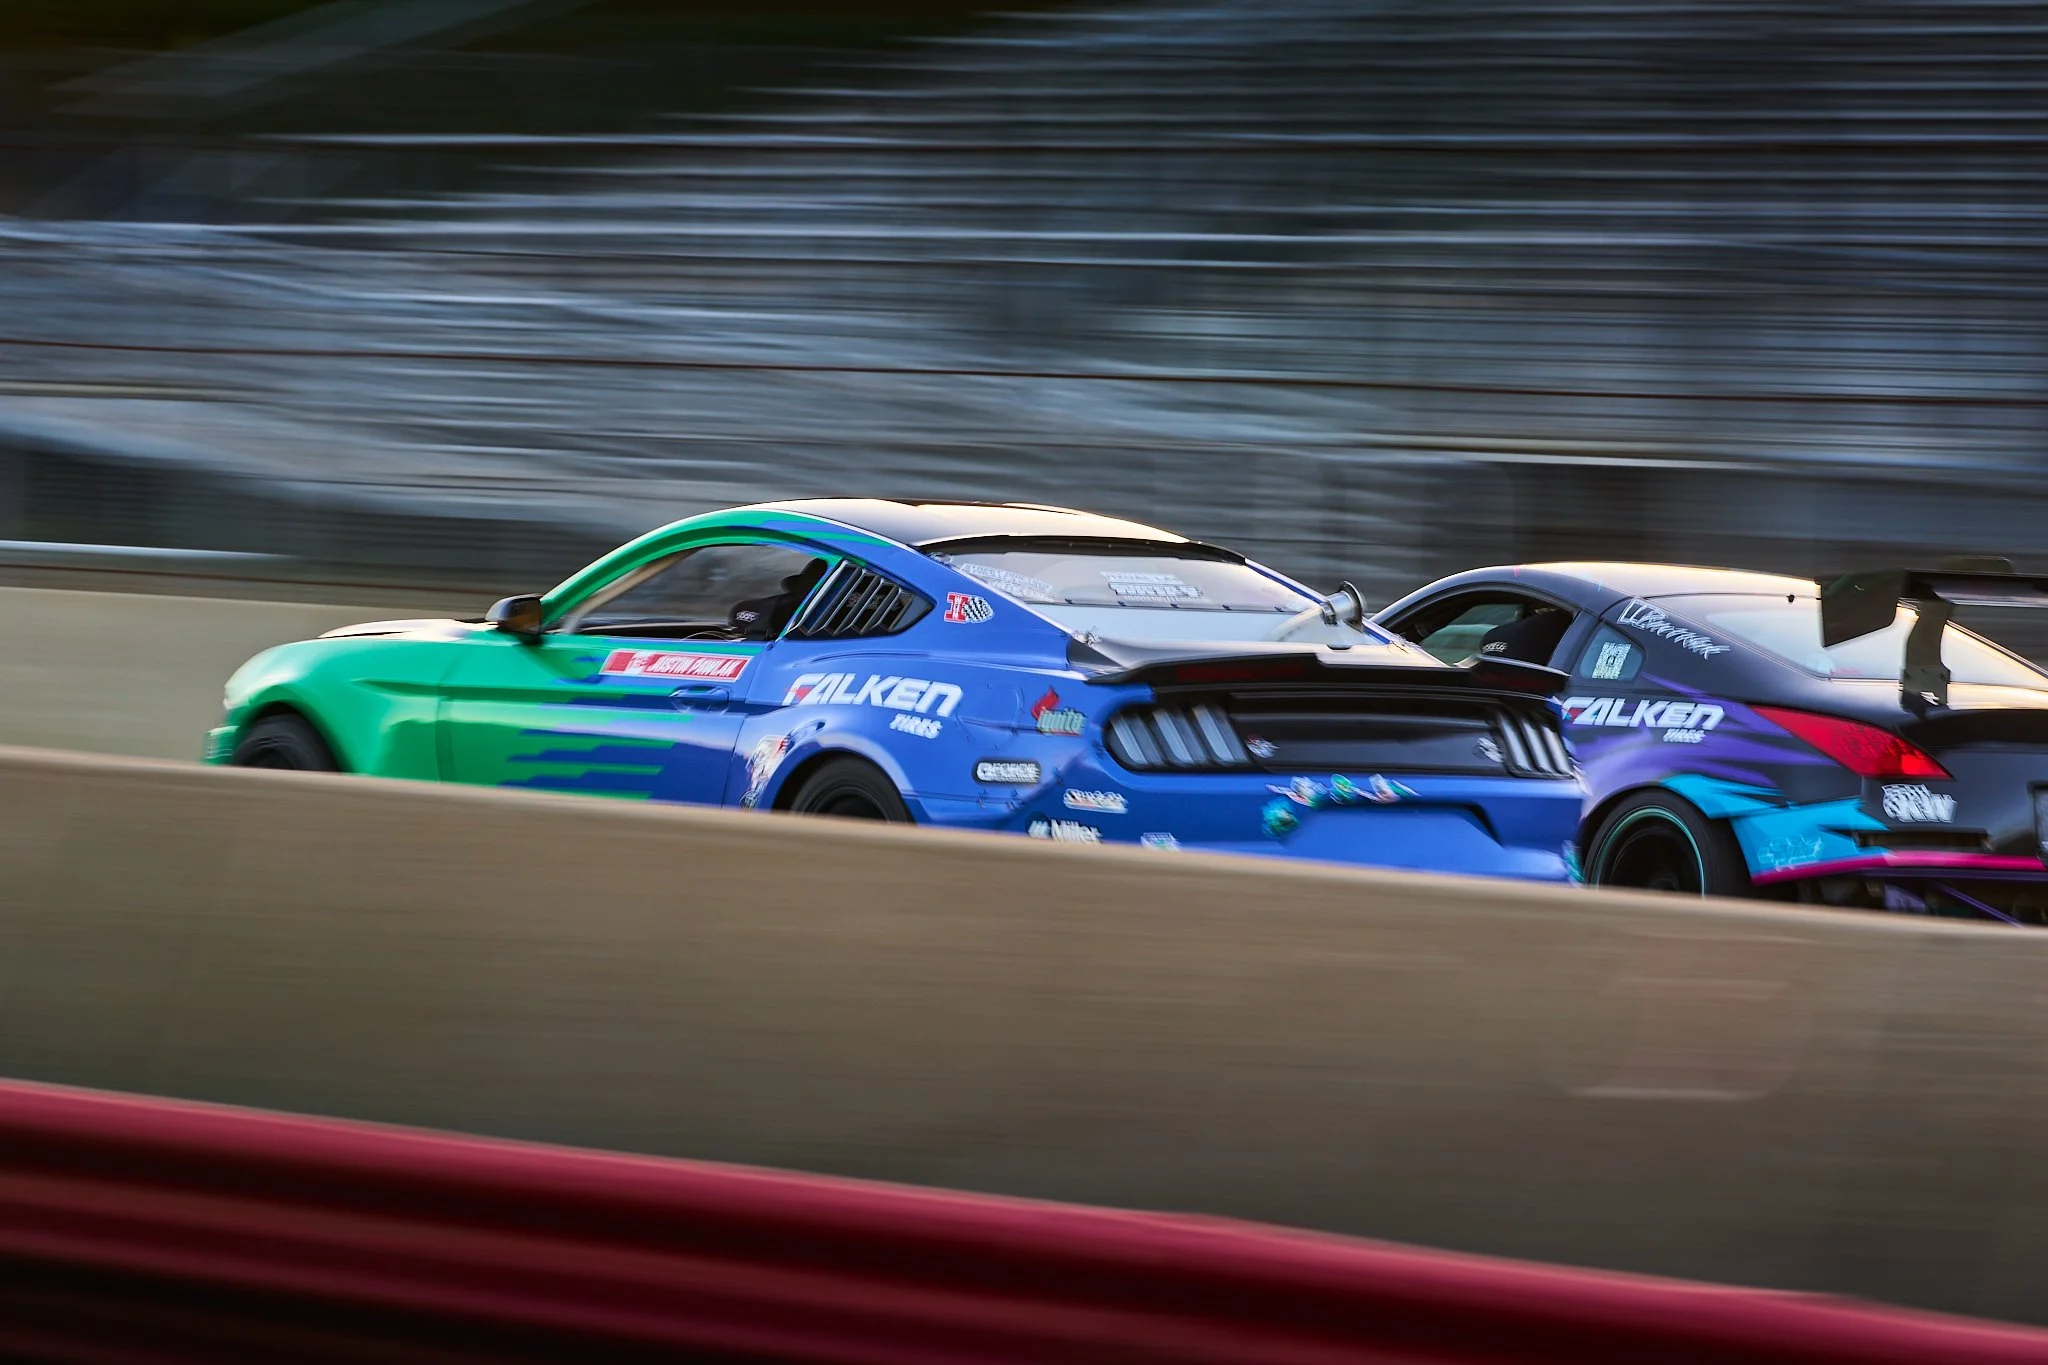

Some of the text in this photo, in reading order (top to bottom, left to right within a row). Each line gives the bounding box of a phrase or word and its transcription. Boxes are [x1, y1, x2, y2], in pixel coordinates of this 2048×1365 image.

[646, 655, 695, 673] JUSTIN
[688, 657, 742, 677] PAWLAK
[782, 673, 963, 717] FALKEN
[1562, 696, 1725, 731] FALKEN
